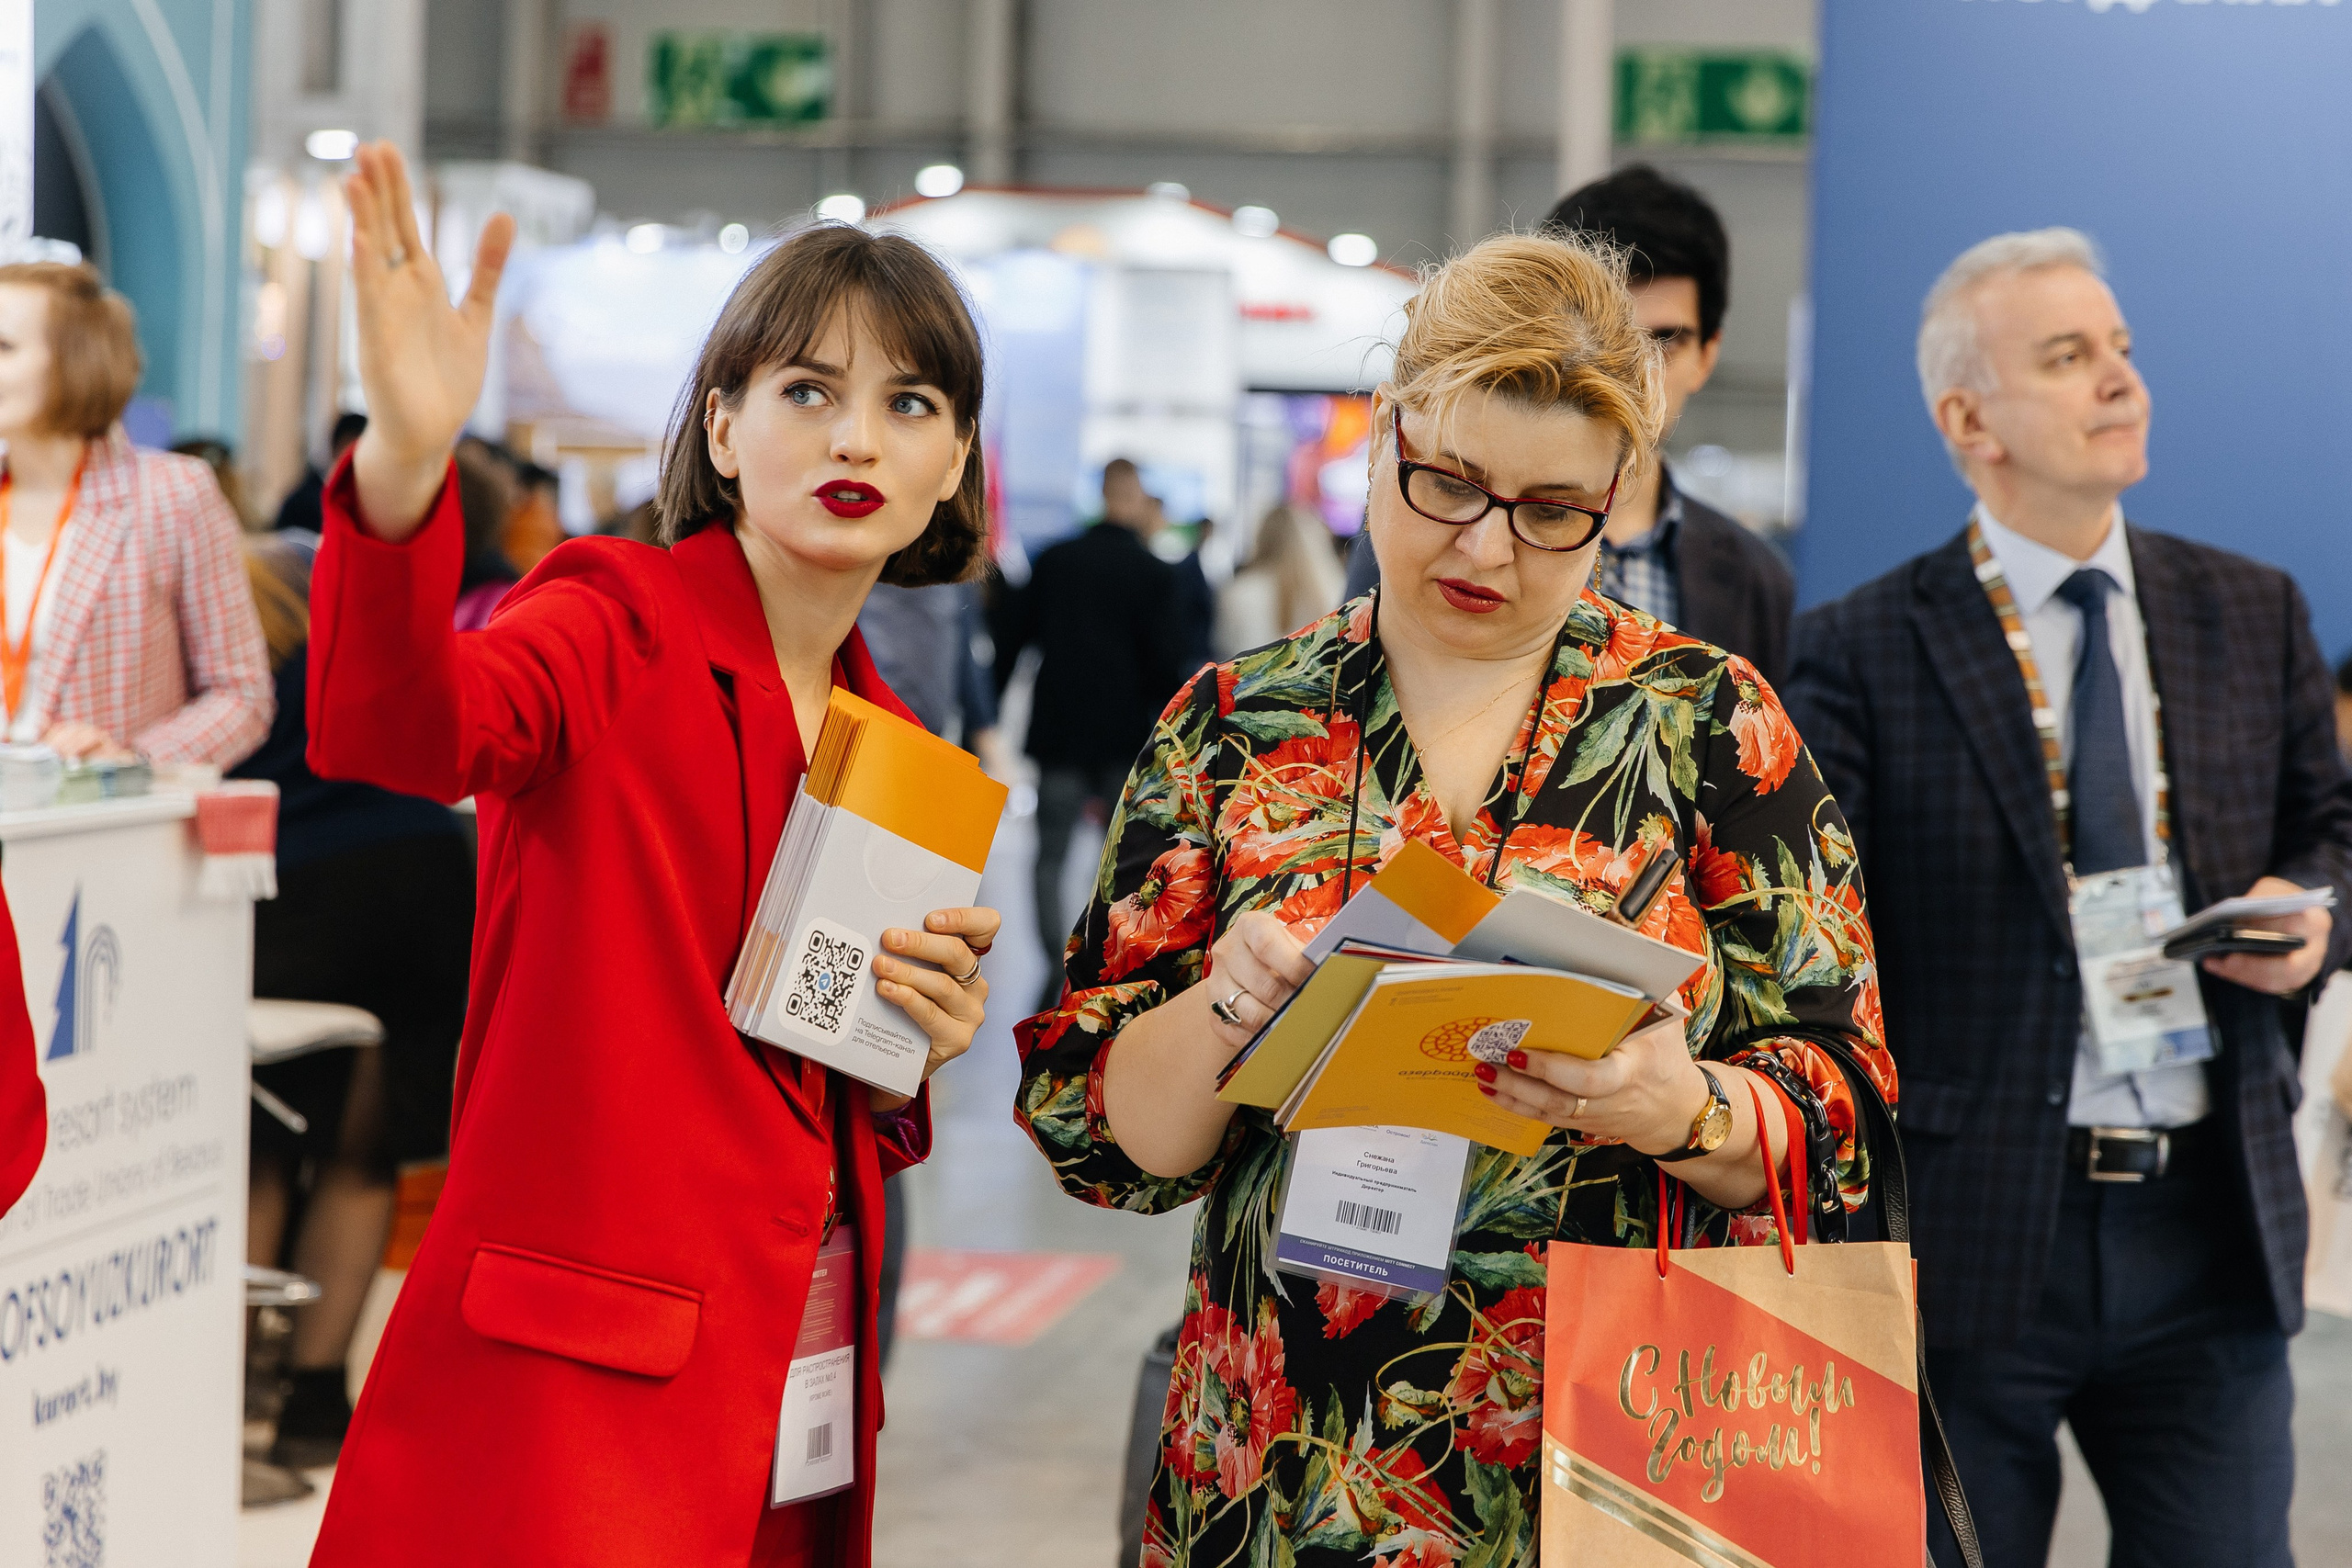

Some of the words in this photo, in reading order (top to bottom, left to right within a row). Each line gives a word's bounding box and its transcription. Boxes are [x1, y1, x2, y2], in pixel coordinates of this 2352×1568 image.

[854, 1027, 864, 1035] на
[865, 1029, 916, 1055] Telegram-канал
[857, 1017, 913, 1045] Подписывайтесь
[851, 1035, 865, 1044] для
[865, 1040, 900, 1058] отельеров
[1356, 1159, 1398, 1175] Григорьева
[1363, 1151, 1396, 1164] Снежана
[1323, 1254, 1389, 1277] ПОСЕТИТЕЛЬ
[802, 1352, 851, 1376] РАСПРОСТРАНЕНИЯ
[1672, 1344, 1855, 1418] Новым
